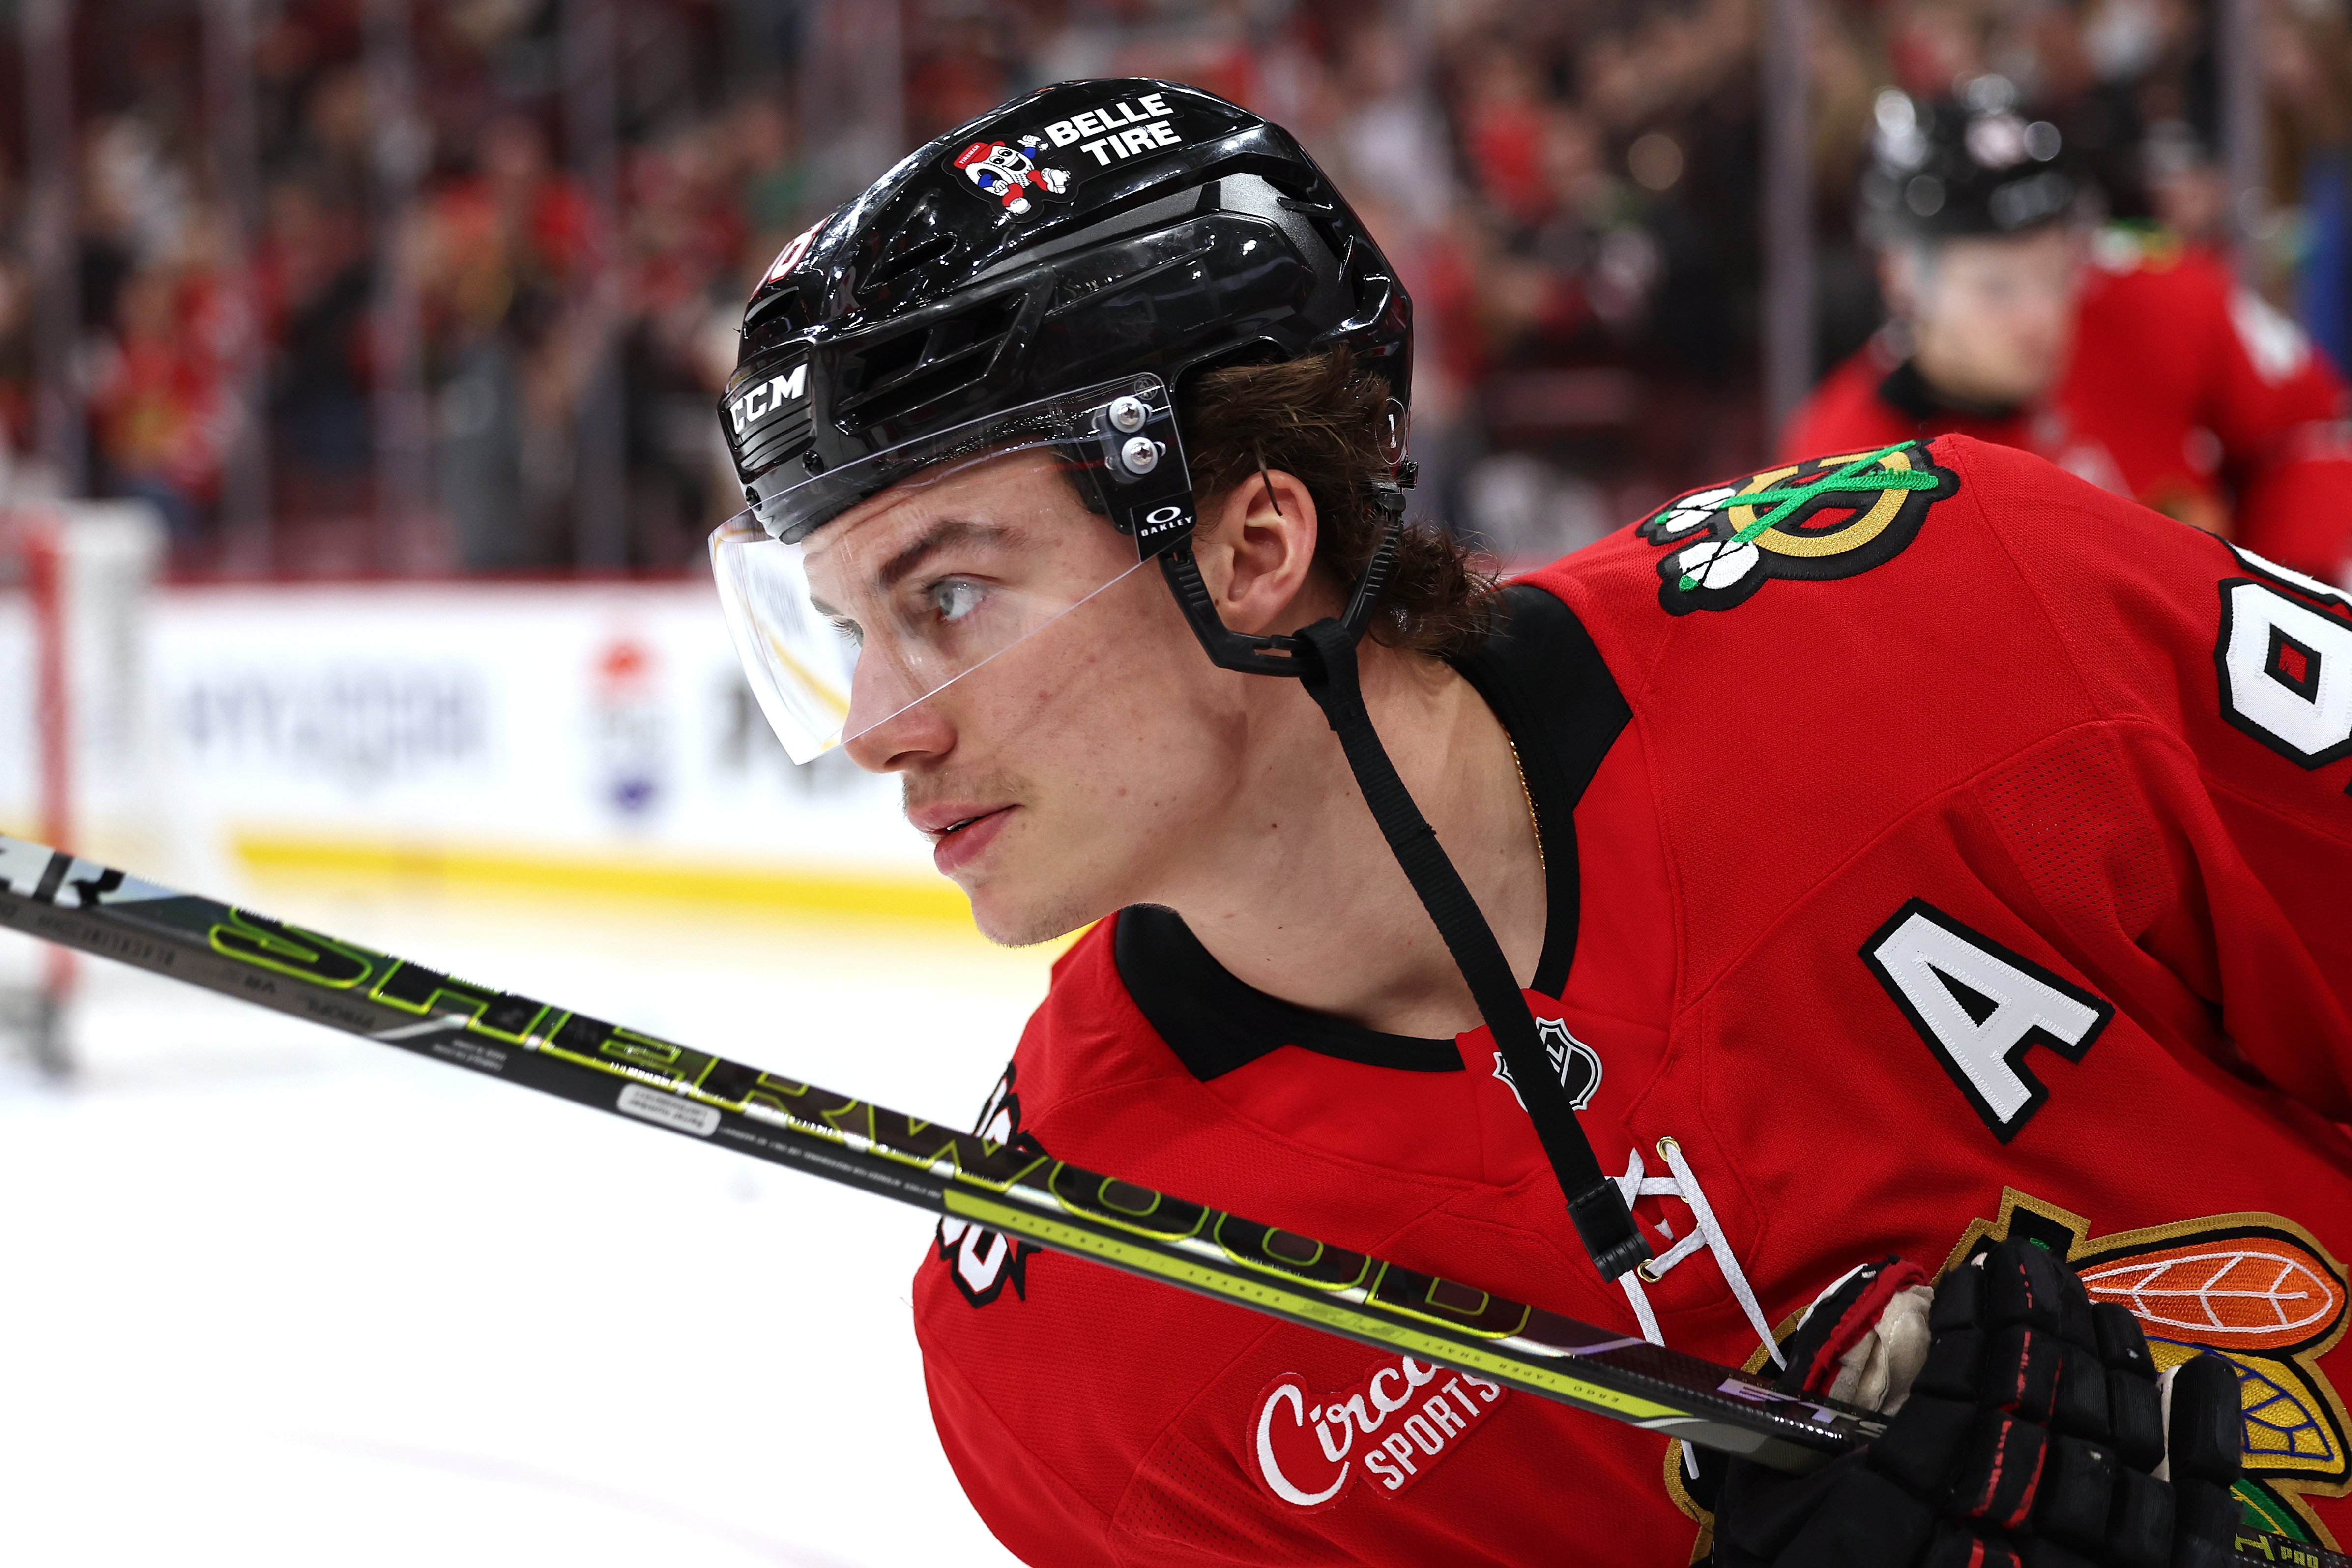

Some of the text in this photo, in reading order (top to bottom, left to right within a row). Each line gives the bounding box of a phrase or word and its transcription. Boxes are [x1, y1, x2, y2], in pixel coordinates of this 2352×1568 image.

[1044, 93, 1174, 148] BELLE
[1080, 120, 1182, 166] TIRE
[958, 145, 980, 164] TIREMAN
[729, 363, 808, 434] CCM
[1140, 516, 1193, 537] OAKLEY
[1858, 896, 2116, 1145] A
[1424, 1342, 1620, 1403] ERGO TAPER SHAFT
[1365, 1372, 1476, 1490] SPORTS
